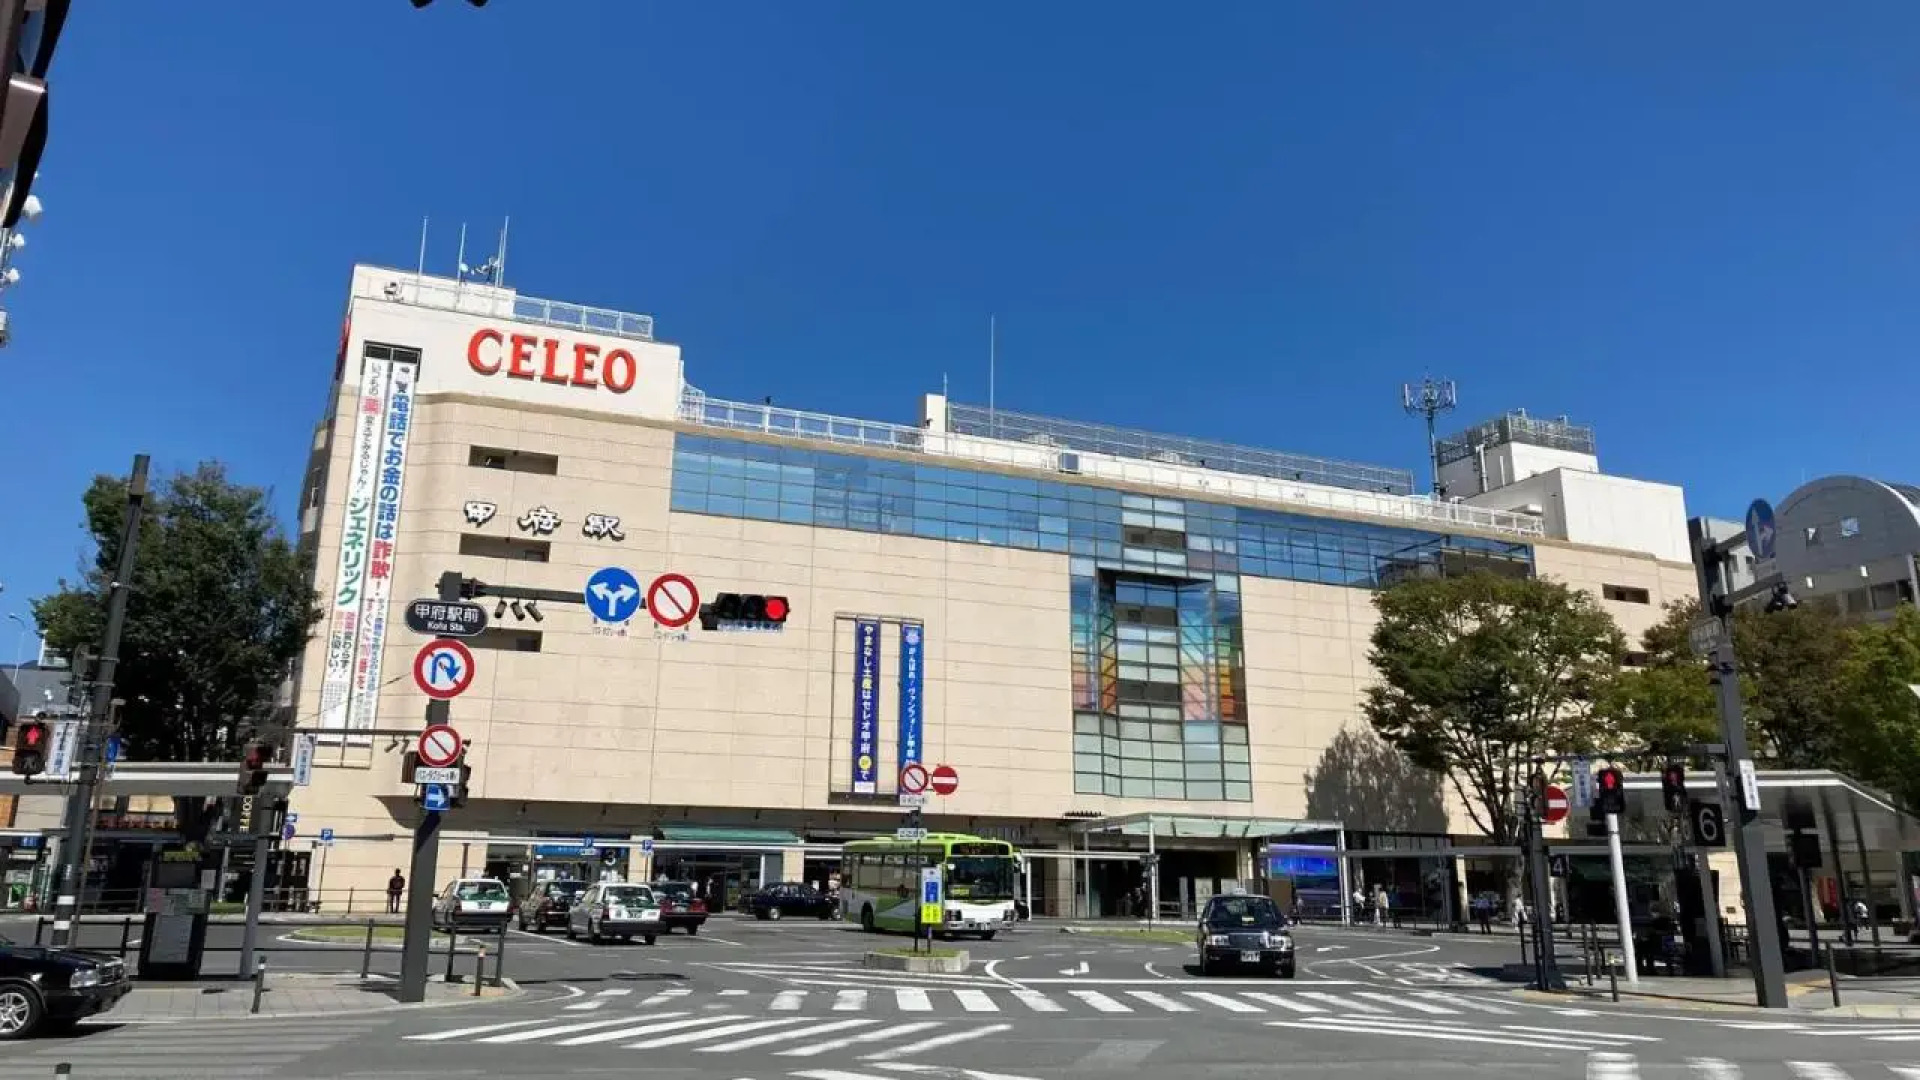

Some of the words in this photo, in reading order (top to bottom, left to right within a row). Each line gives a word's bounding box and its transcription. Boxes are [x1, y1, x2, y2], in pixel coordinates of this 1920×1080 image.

[468, 328, 637, 393] CELEO
[464, 501, 625, 541] 甲府駅
[336, 497, 373, 606] ジェネリック
[415, 603, 479, 623] 甲府駅前
[427, 620, 448, 631] Kofu
[1699, 807, 1718, 841] 6
[1553, 858, 1564, 874] 4
